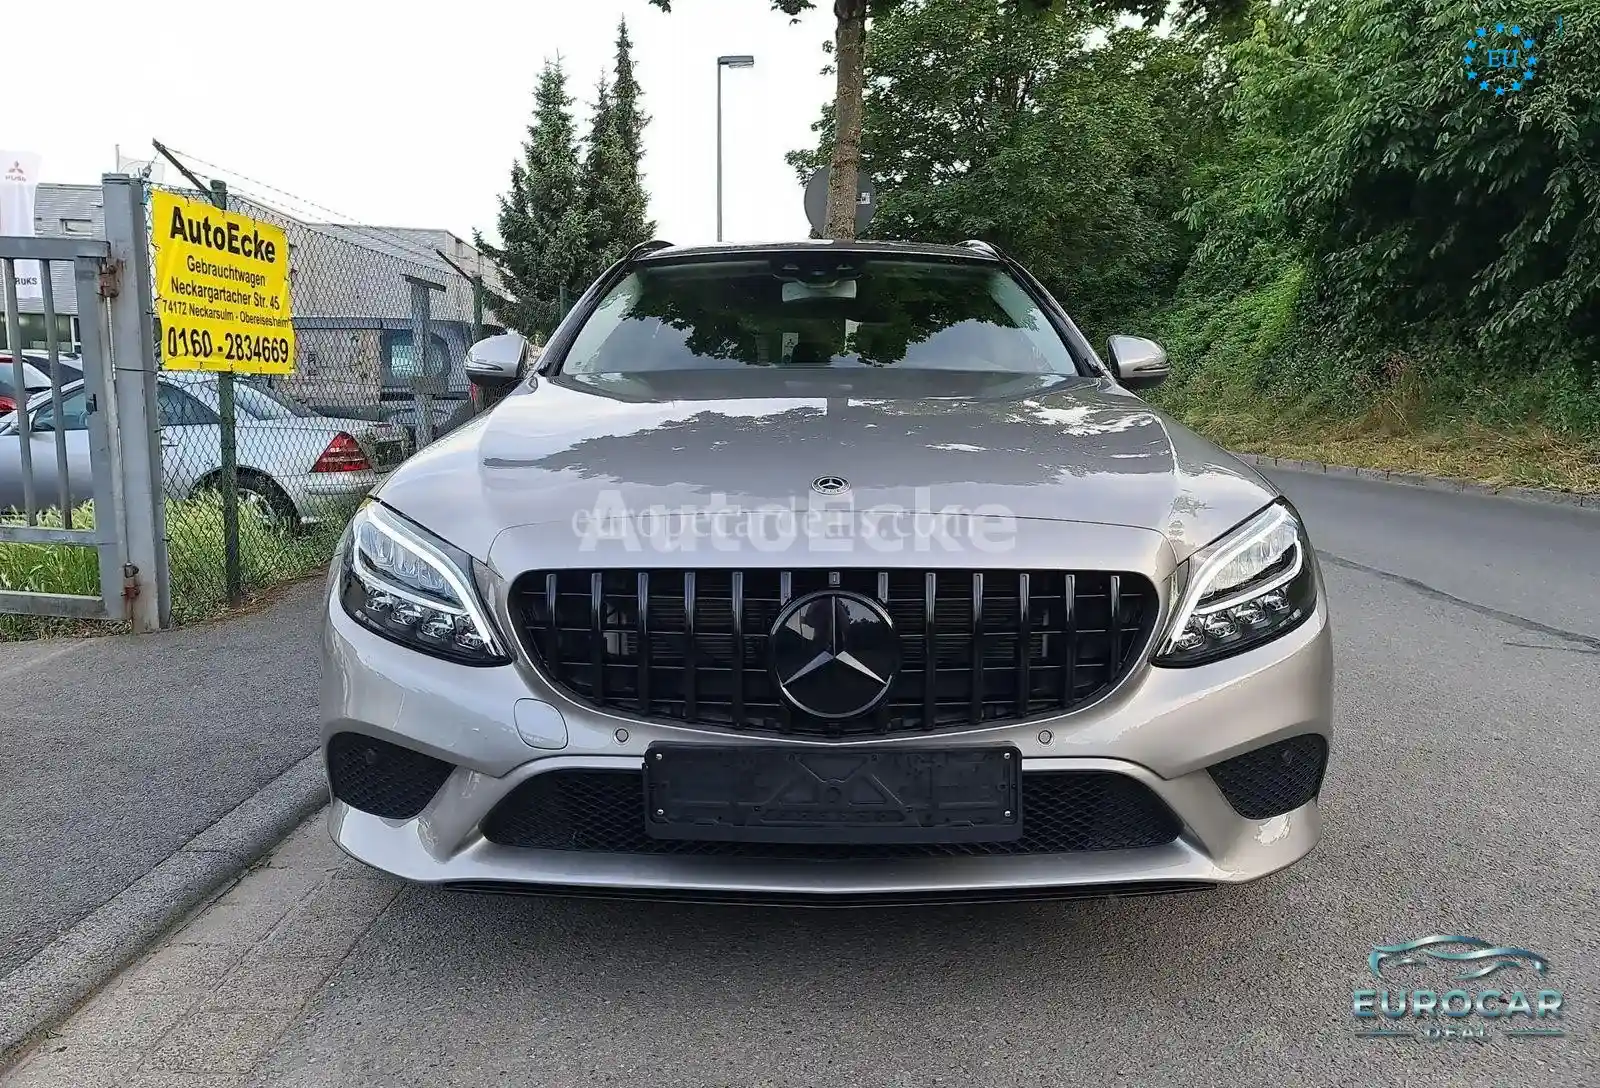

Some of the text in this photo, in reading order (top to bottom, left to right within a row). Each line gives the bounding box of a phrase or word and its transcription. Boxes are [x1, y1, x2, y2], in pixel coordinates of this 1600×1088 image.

[169, 206, 276, 263] AutoEcke
[186, 255, 266, 286] Gebrauchtwagen
[171, 276, 280, 310] Neckargartacher Str. 45
[162, 300, 187, 316] 74172
[188, 304, 235, 321] Neckarsulm
[167, 326, 213, 358] 0160
[224, 332, 289, 363] 2834669
